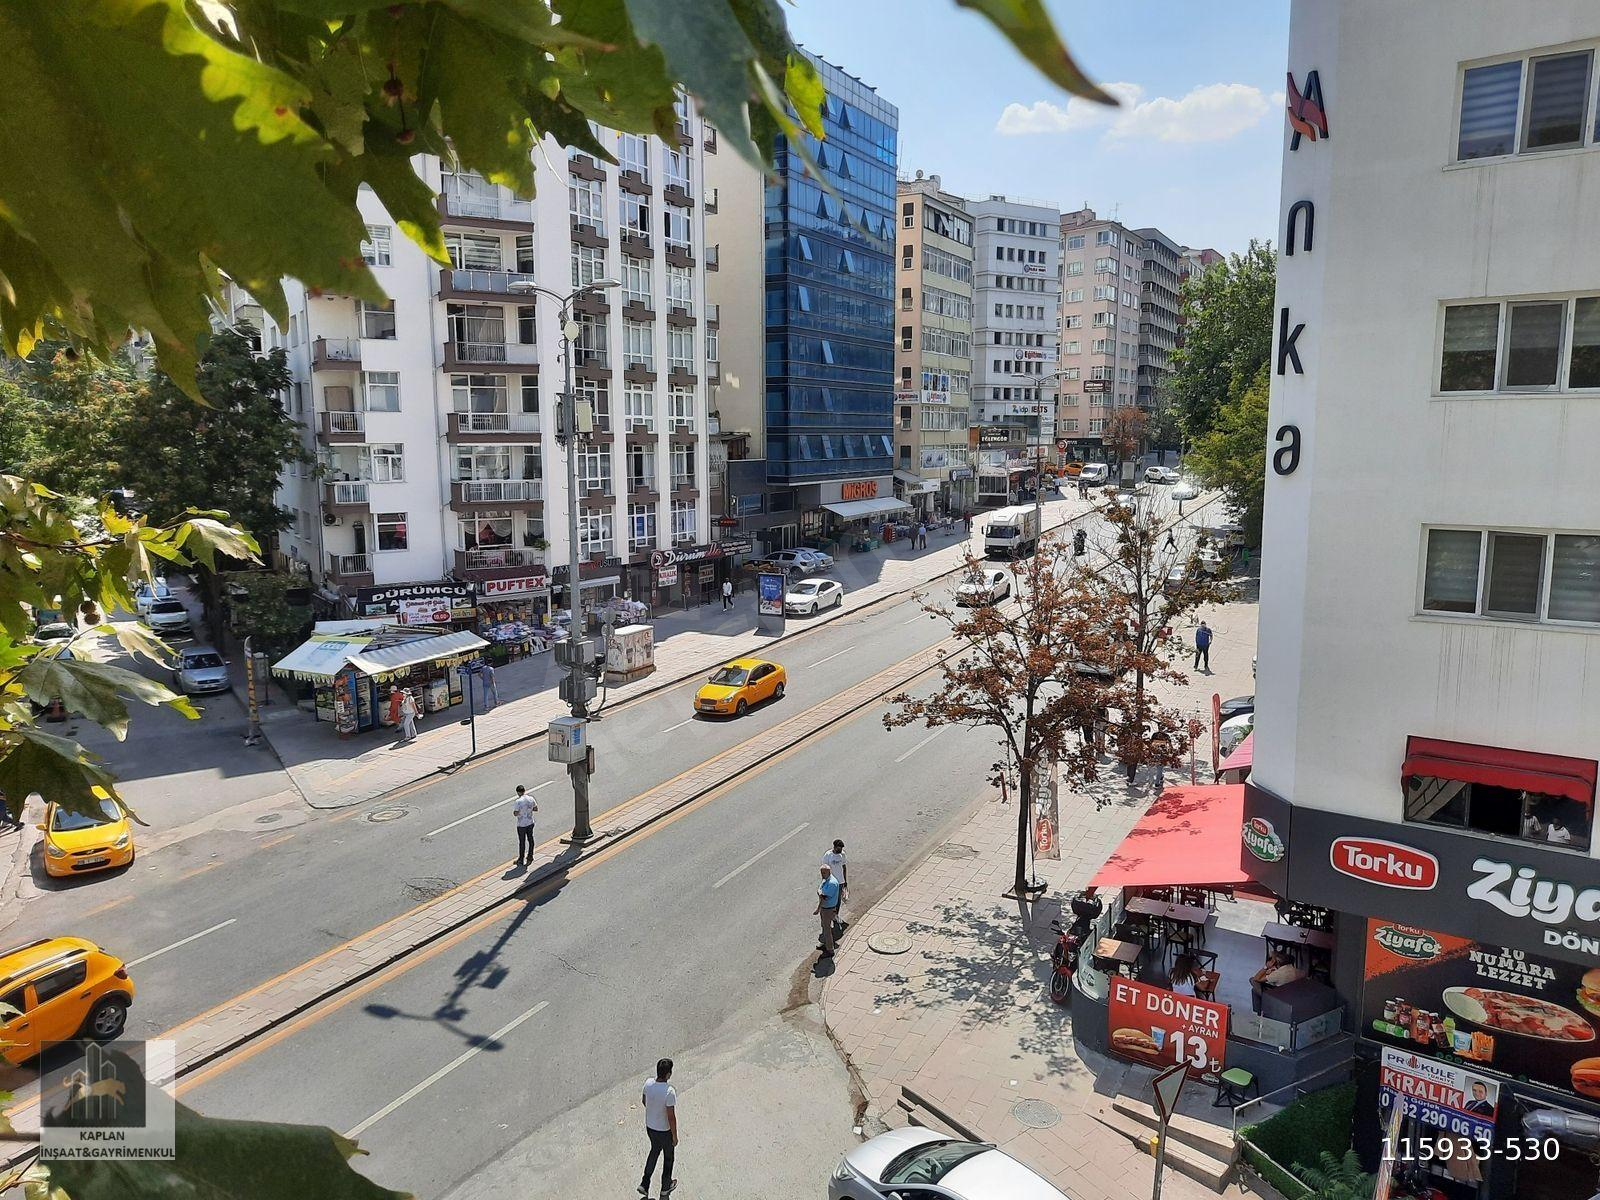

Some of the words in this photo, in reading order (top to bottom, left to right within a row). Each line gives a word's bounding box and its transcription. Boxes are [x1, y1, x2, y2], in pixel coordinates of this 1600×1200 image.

[372, 585, 467, 602] DÜRÜMCÜ
[486, 576, 545, 593] PUFTEX
[1242, 822, 1280, 857] Ziyafet
[1342, 844, 1423, 881] Torku
[1374, 928, 1442, 955] Ziyafet
[1397, 924, 1420, 934] Torku
[1468, 950, 1556, 980] NUMARA
[1476, 964, 1547, 990] LEZZET
[1116, 984, 1141, 1006] ET
[1146, 993, 1220, 1029] DÖNER
[1188, 1025, 1219, 1039] AYRAN
[1170, 1031, 1208, 1069] 13
[1421, 1108, 1448, 1128] 290
[1451, 1118, 1470, 1136] 06
[1473, 1126, 1492, 1140] 50
